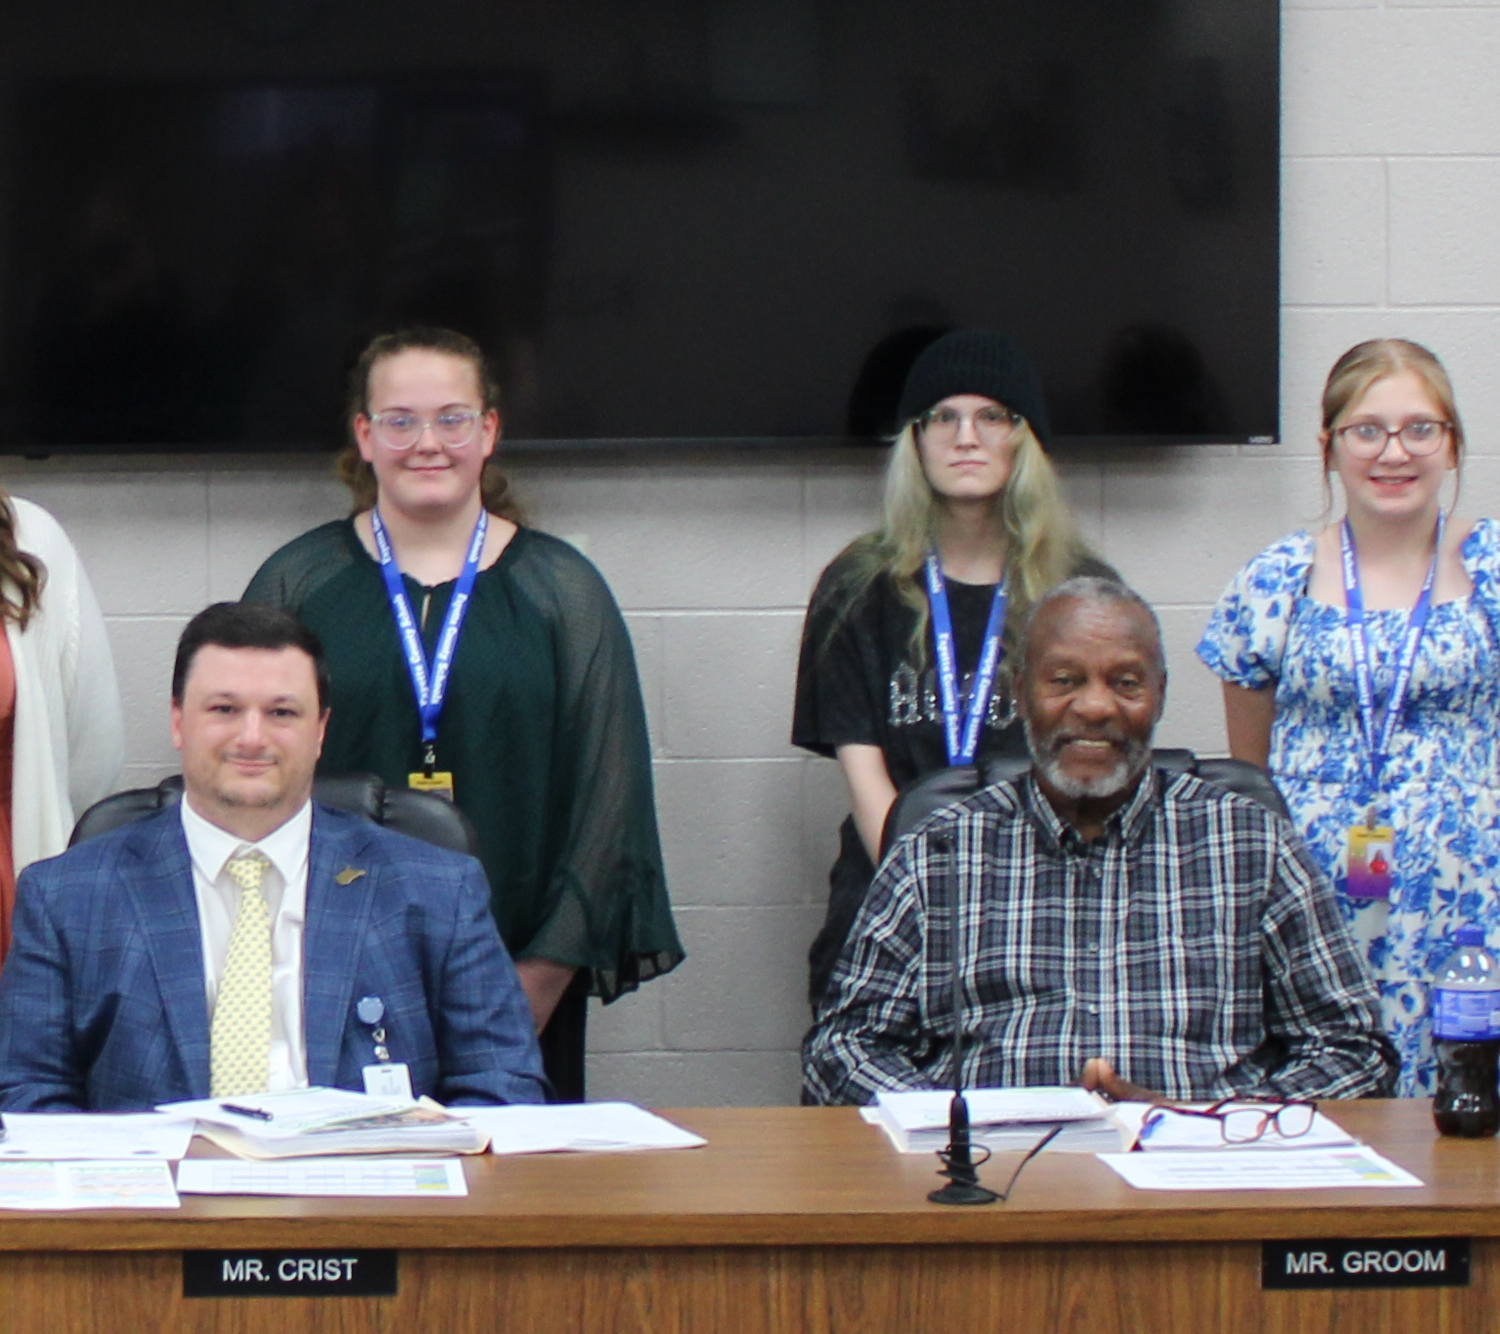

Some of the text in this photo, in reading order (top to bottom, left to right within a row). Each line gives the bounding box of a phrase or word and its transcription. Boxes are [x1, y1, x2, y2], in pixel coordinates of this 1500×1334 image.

[393, 592, 412, 628] Schools
[404, 628, 422, 665] County
[438, 626, 458, 660] County
[431, 663, 449, 705] Schools
[941, 673, 955, 712] County
[971, 676, 992, 716] County
[1355, 663, 1371, 706] County
[222, 1259, 358, 1281] MR. CRIST
[1286, 1250, 1446, 1274] MR. GROOM
